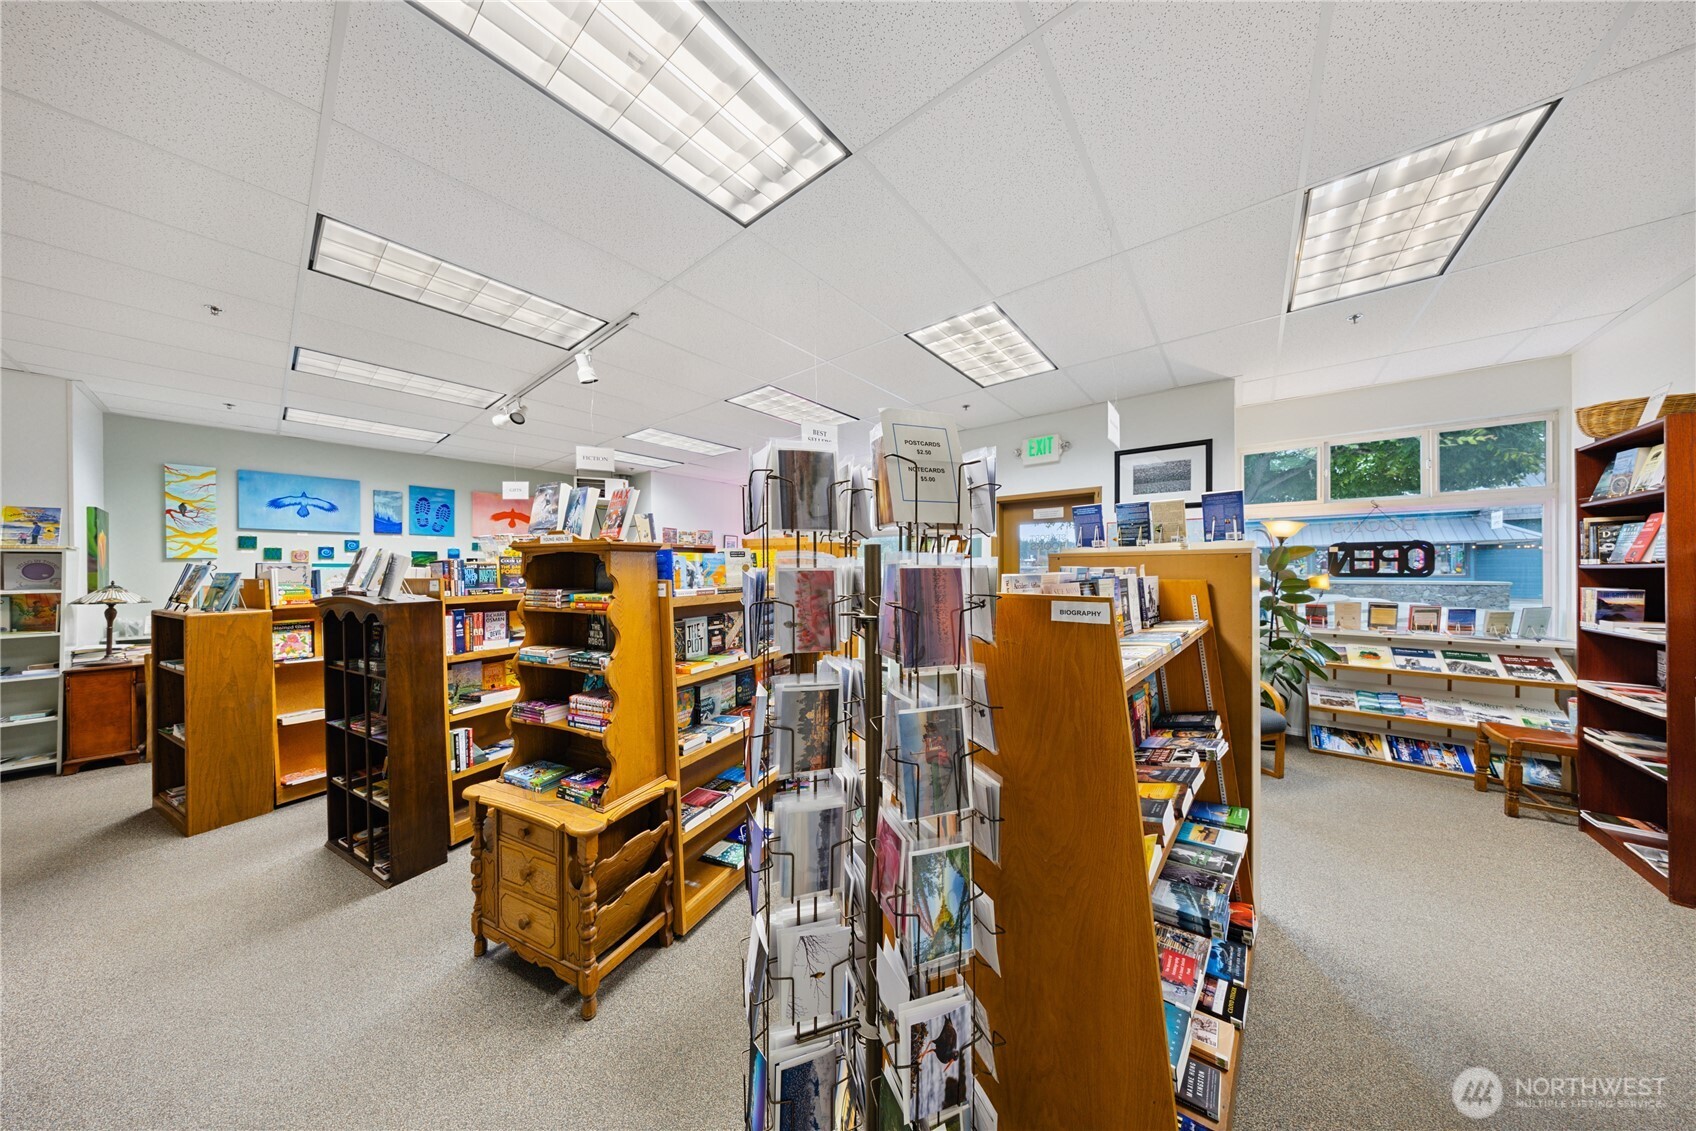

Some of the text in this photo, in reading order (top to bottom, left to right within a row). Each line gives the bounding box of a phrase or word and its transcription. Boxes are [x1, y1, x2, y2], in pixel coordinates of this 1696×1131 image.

[812, 429, 828, 437] BEST
[904, 439, 941, 448] POSTCARDS
[1028, 436, 1054, 457] EXIT
[907, 466, 946, 474] NOTECARDS
[1059, 609, 1102, 617] BIOGRAPHY
[687, 623, 701, 639] THE
[687, 637, 704, 653] PLOT
[1186, 1077, 1195, 1098] MAXINE
[1196, 1070, 1205, 1097] KINGSTON
